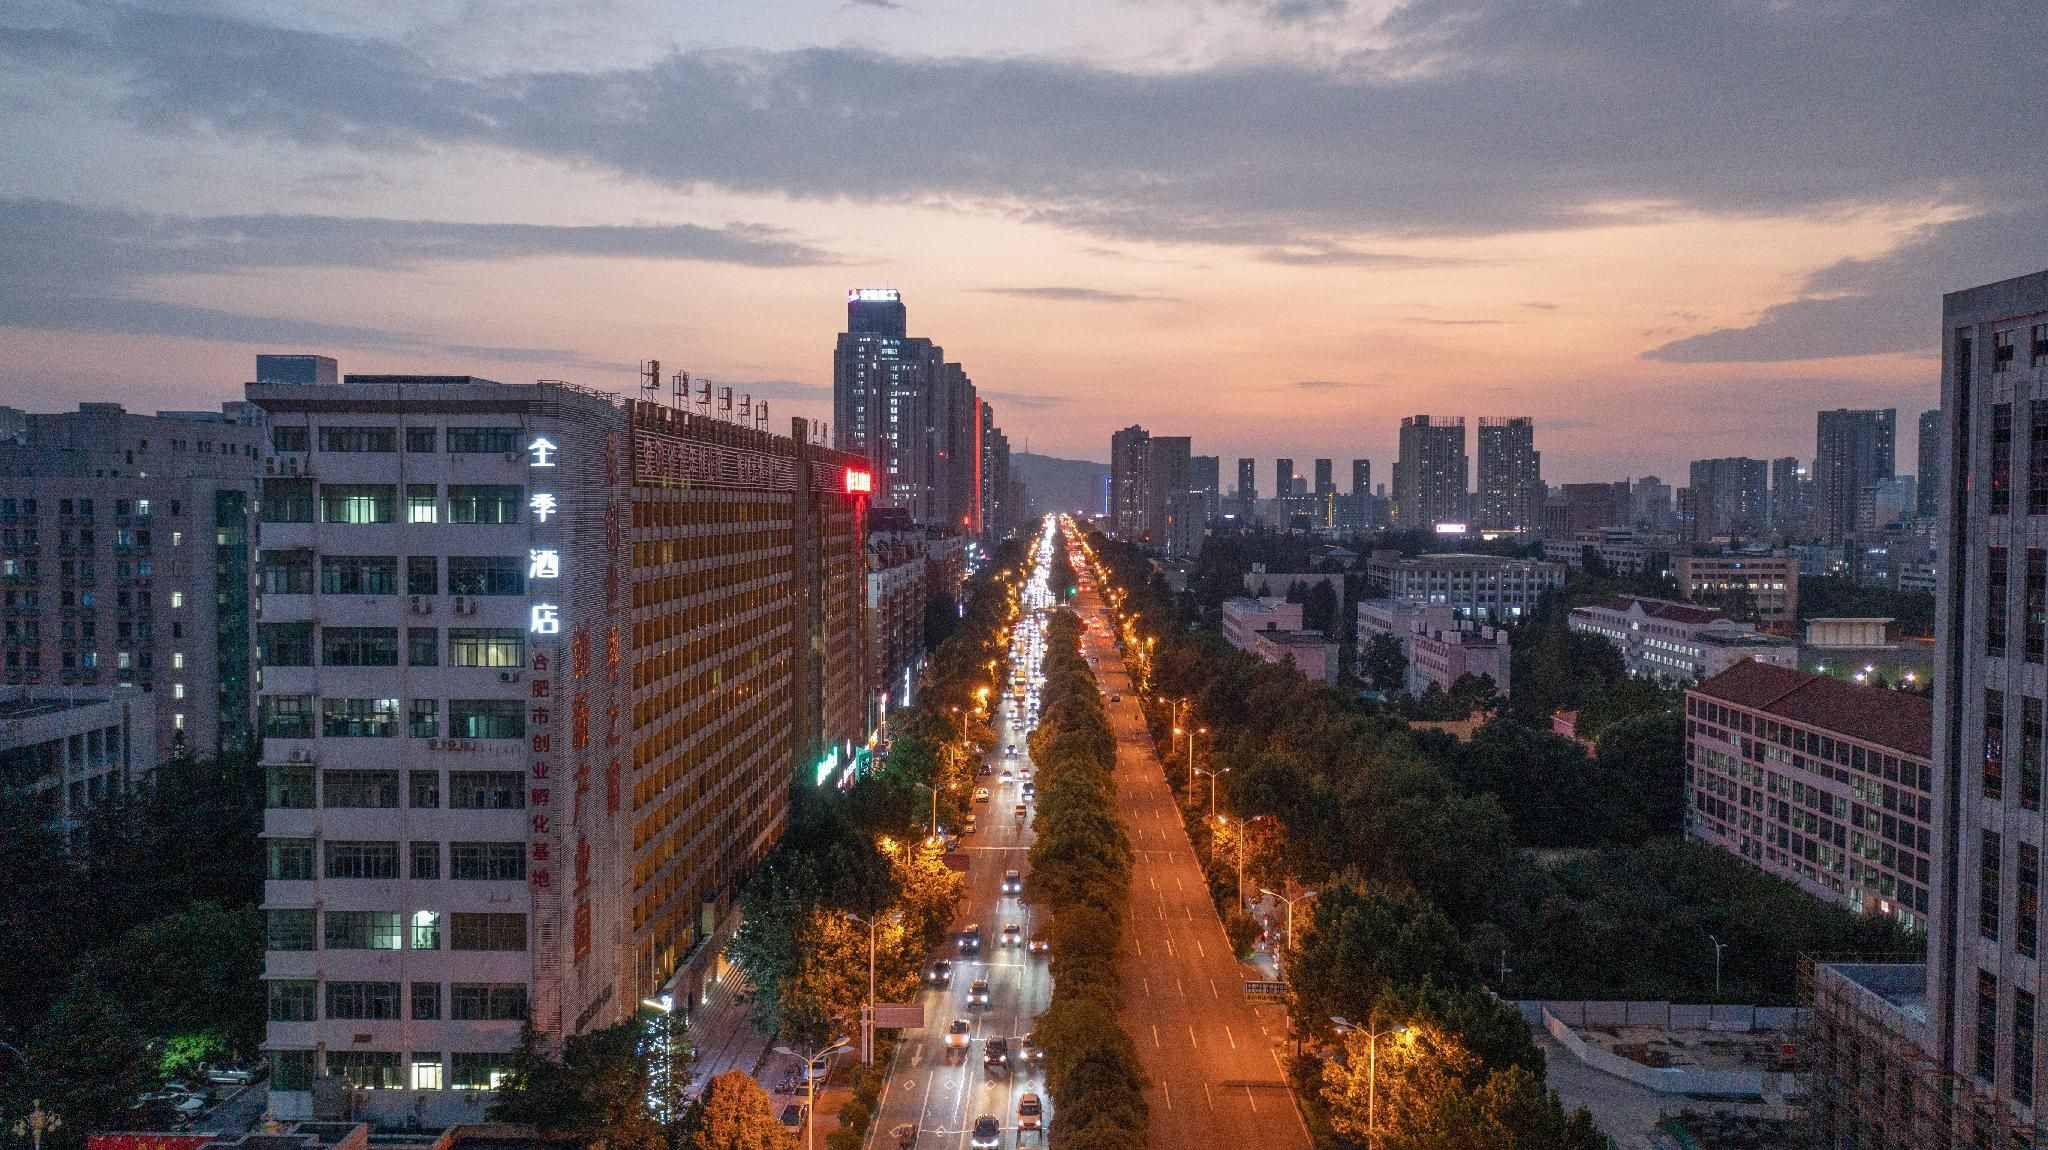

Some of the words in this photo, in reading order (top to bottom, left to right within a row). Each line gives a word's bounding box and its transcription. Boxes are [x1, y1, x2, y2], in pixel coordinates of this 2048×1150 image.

[528, 438, 558, 633] 全季酒店
[532, 653, 550, 888] 合肥市创业孵化基地
